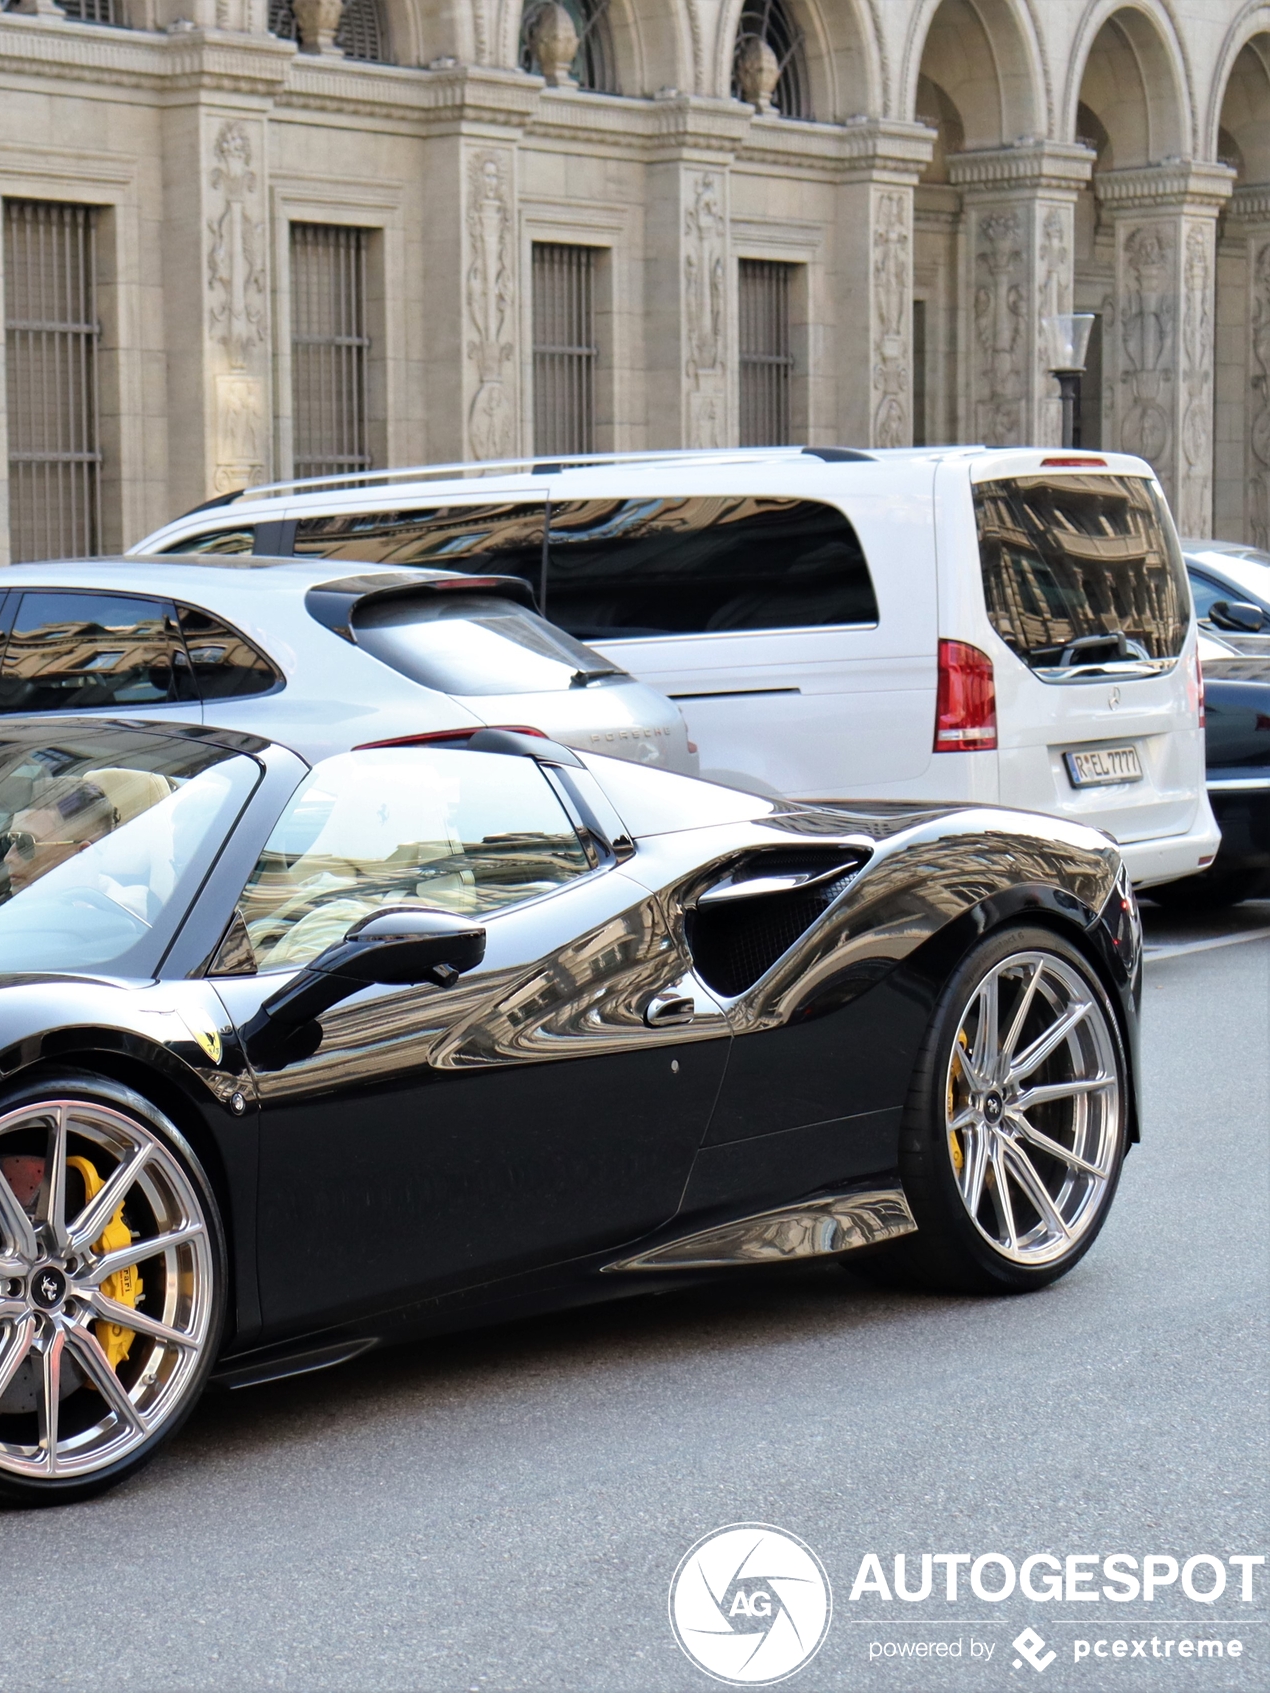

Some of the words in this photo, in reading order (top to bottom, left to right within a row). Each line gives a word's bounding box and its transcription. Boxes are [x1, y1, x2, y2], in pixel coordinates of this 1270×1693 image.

[591, 727, 671, 743] PORSCHE
[1075, 756, 1088, 778] R
[1090, 754, 1110, 776] EL
[1107, 750, 1137, 774] 7777
